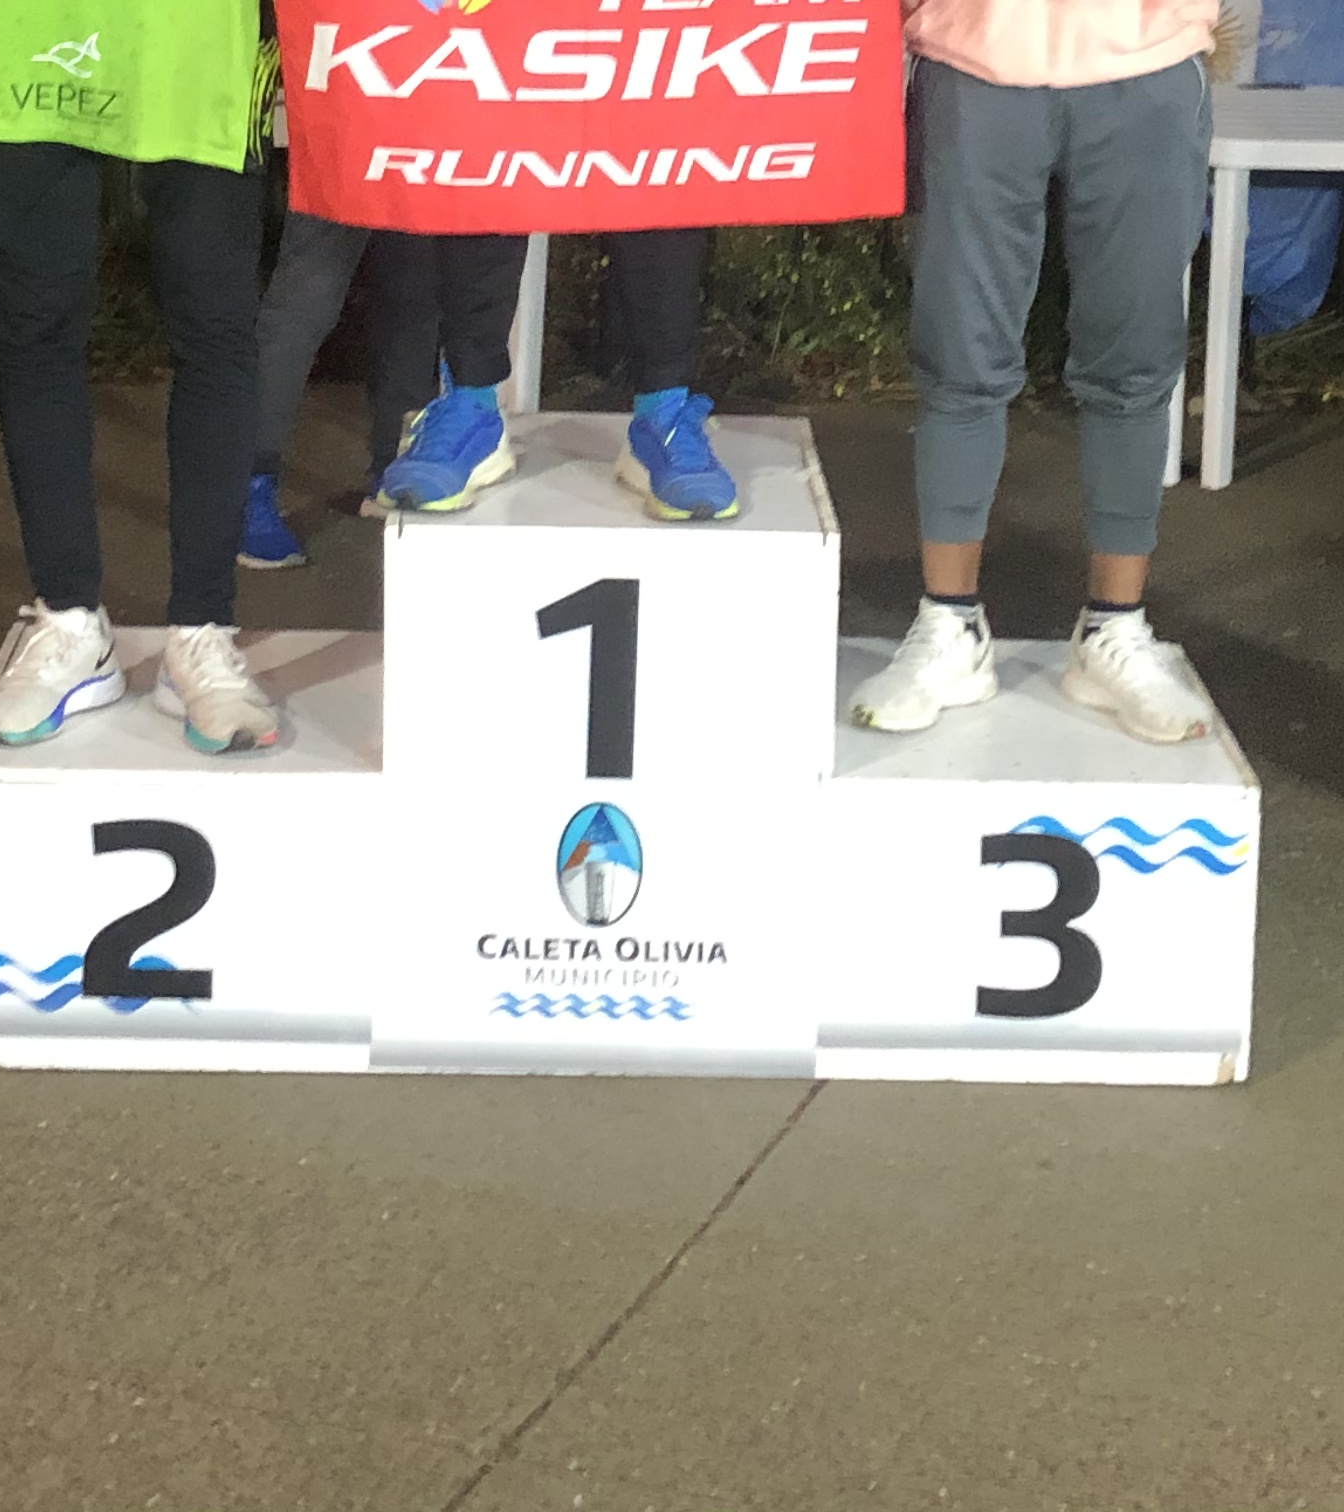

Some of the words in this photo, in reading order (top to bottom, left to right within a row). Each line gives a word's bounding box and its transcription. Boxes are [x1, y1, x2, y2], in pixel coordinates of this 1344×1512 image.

[303, 18, 869, 103] KASIKE
[362, 141, 818, 189] RUNNING
[536, 578, 641, 780] 1
[80, 819, 217, 1001] 2
[476, 933, 603, 961] CALETA
[614, 936, 729, 964] OLIVIA
[974, 832, 1105, 1020] 3
[524, 966, 680, 988] MUNICIPIO
